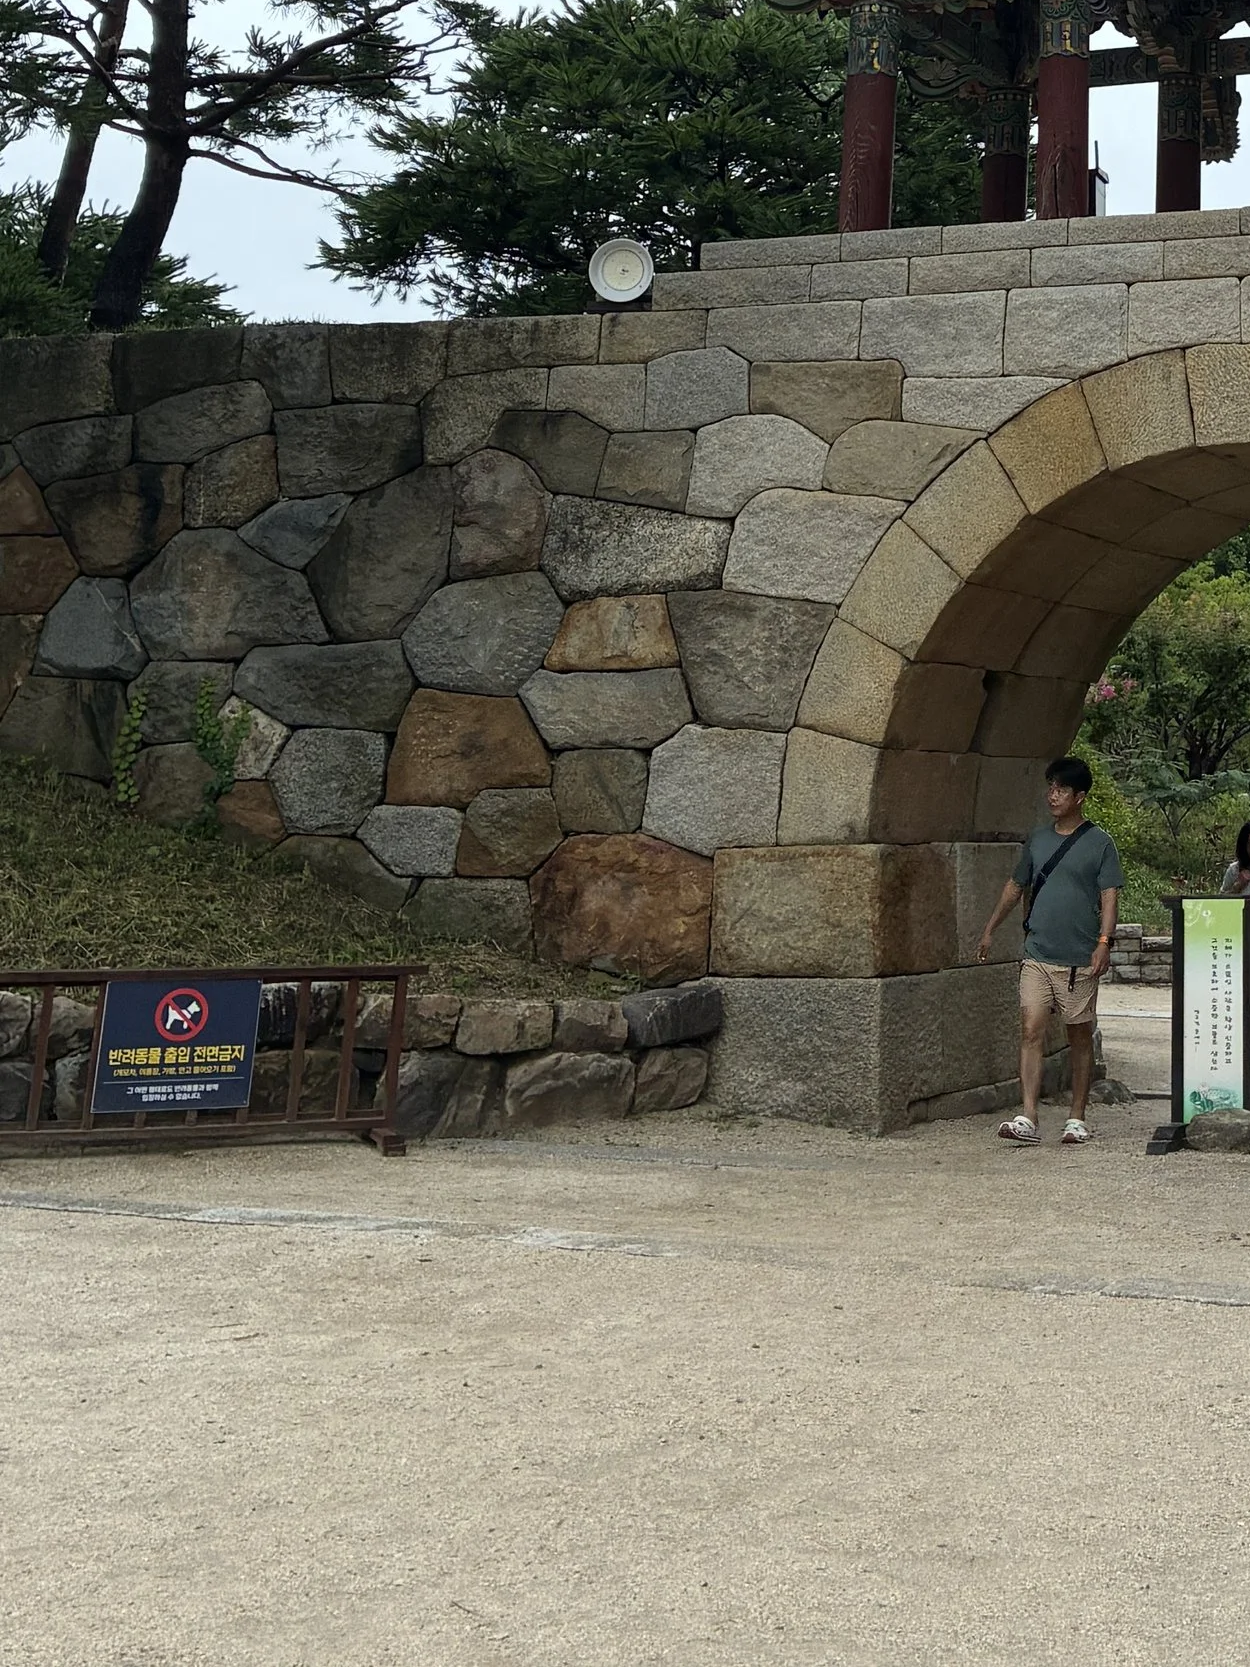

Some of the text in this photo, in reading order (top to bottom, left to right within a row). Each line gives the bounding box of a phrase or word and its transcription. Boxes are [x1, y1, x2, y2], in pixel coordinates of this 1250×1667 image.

[108, 1044, 245, 1066] 반려동물 출입 전면금지
